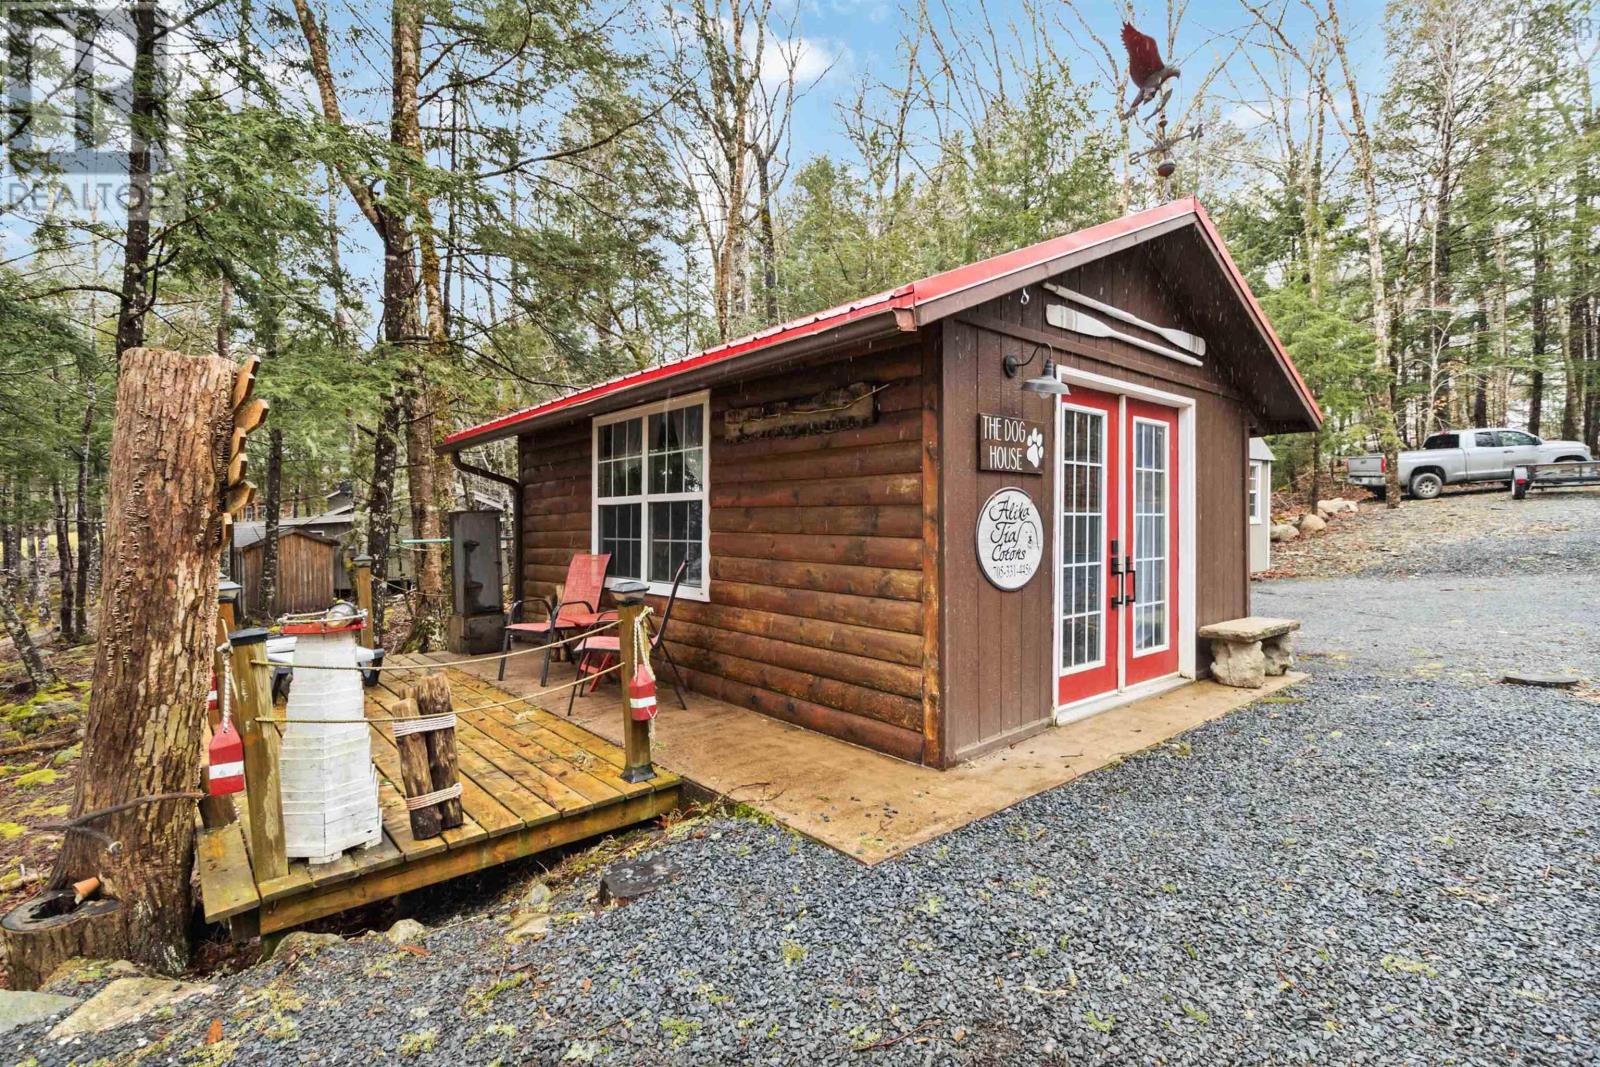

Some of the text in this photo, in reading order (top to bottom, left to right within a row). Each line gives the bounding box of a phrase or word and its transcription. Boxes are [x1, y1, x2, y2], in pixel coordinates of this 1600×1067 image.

[983, 416, 1026, 442] THE DOG
[989, 445, 1022, 471] HOUSE
